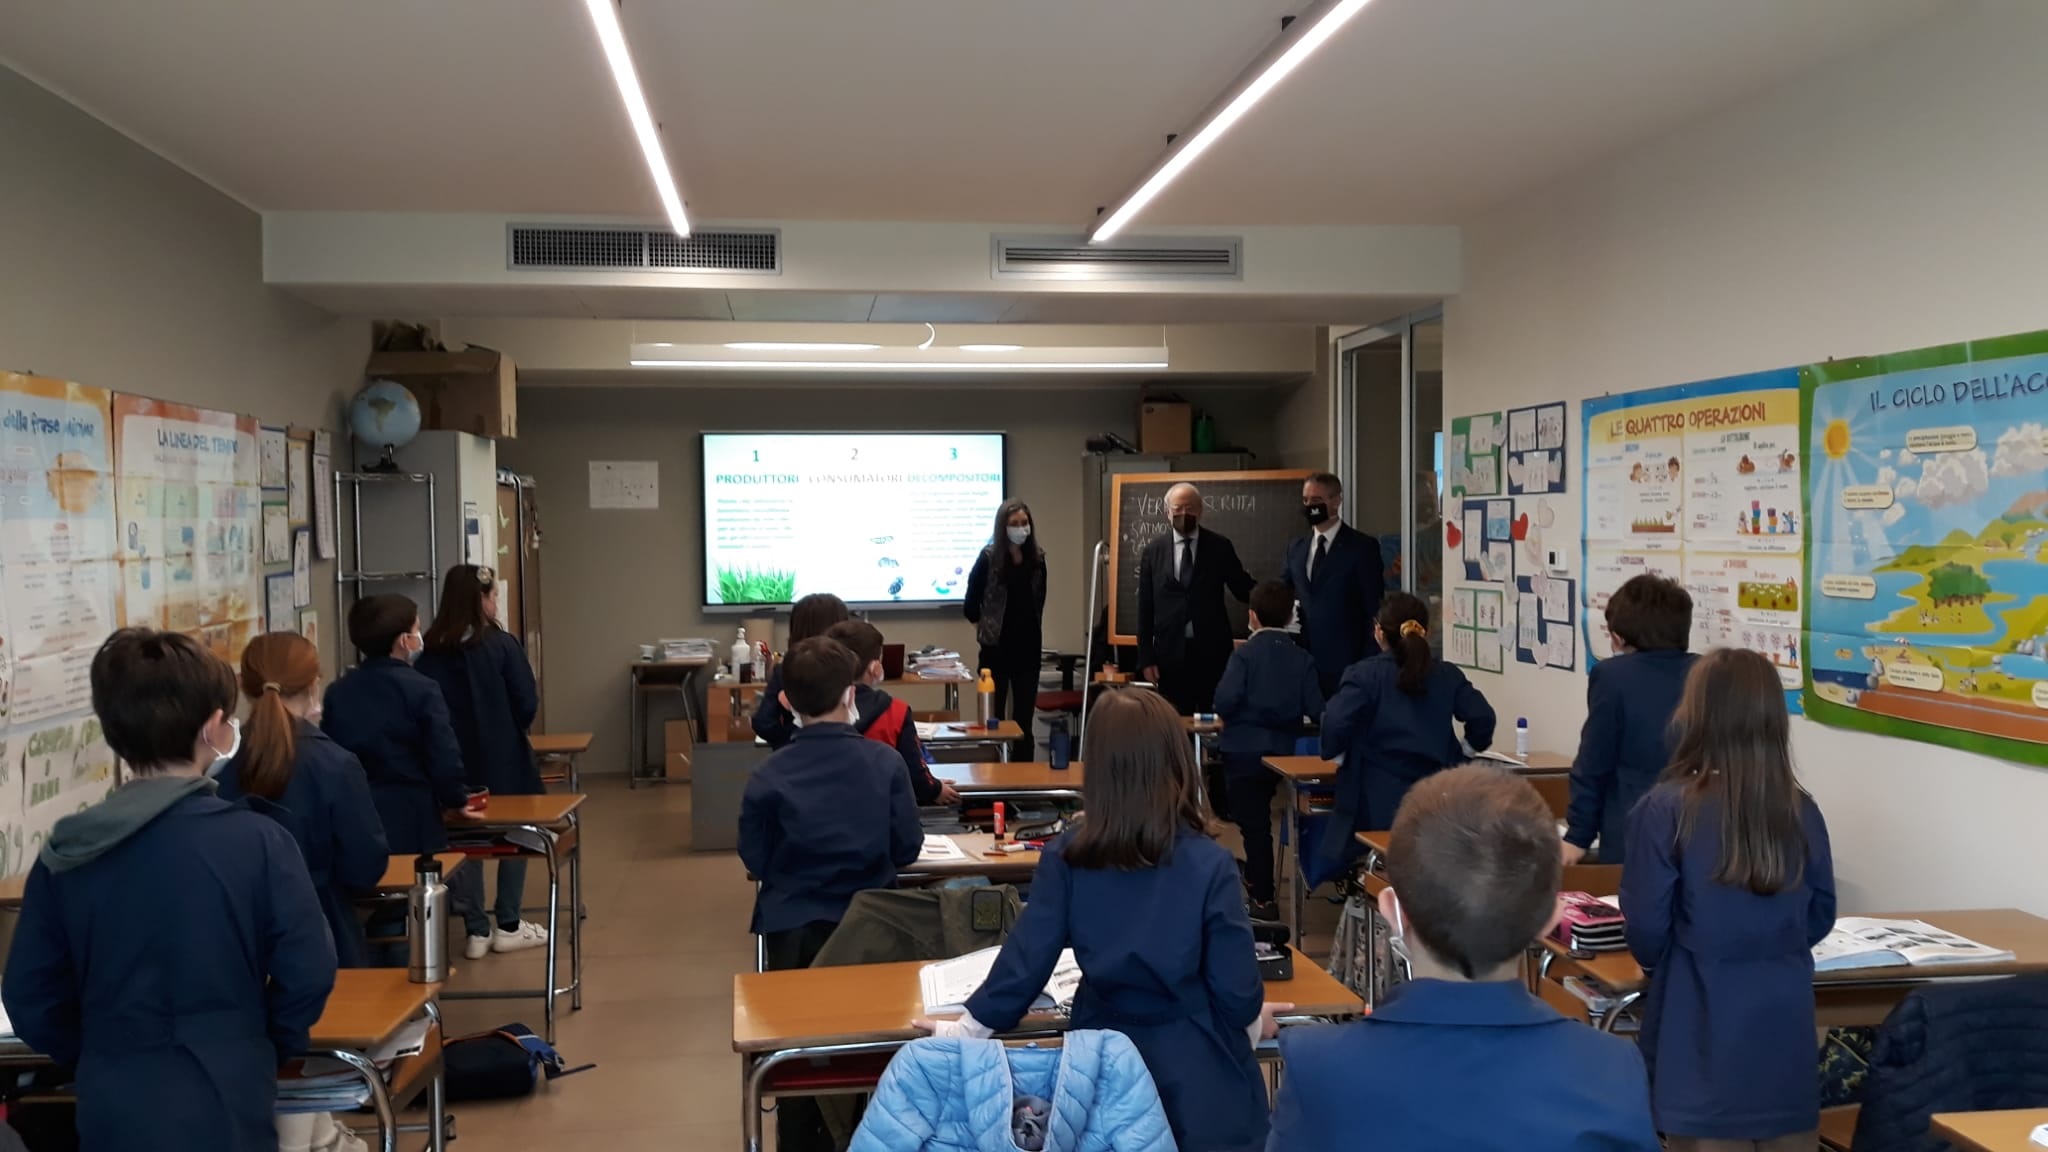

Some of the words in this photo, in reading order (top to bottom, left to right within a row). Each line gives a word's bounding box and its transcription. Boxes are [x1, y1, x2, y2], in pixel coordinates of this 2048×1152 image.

[1870, 392, 1887, 413] IL
[1892, 383, 1945, 411] CICLO
[1953, 372, 2048, 403] DELL'AC
[31, 411, 60, 435] frase
[1610, 420, 1623, 438] LE
[1626, 412, 1685, 437] QUATTRO
[1689, 401, 1766, 429] OPERAZIONI
[157, 428, 168, 446] LA
[192, 434, 209, 451] DEL
[752, 450, 760, 462] 1
[850, 448, 859, 461] 2
[949, 447, 958, 461] 3
[716, 473, 799, 485] PRODUTTORI
[808, 473, 903, 484] CONSUMATORI
[907, 472, 1001, 483] DECOMPOSITORI
